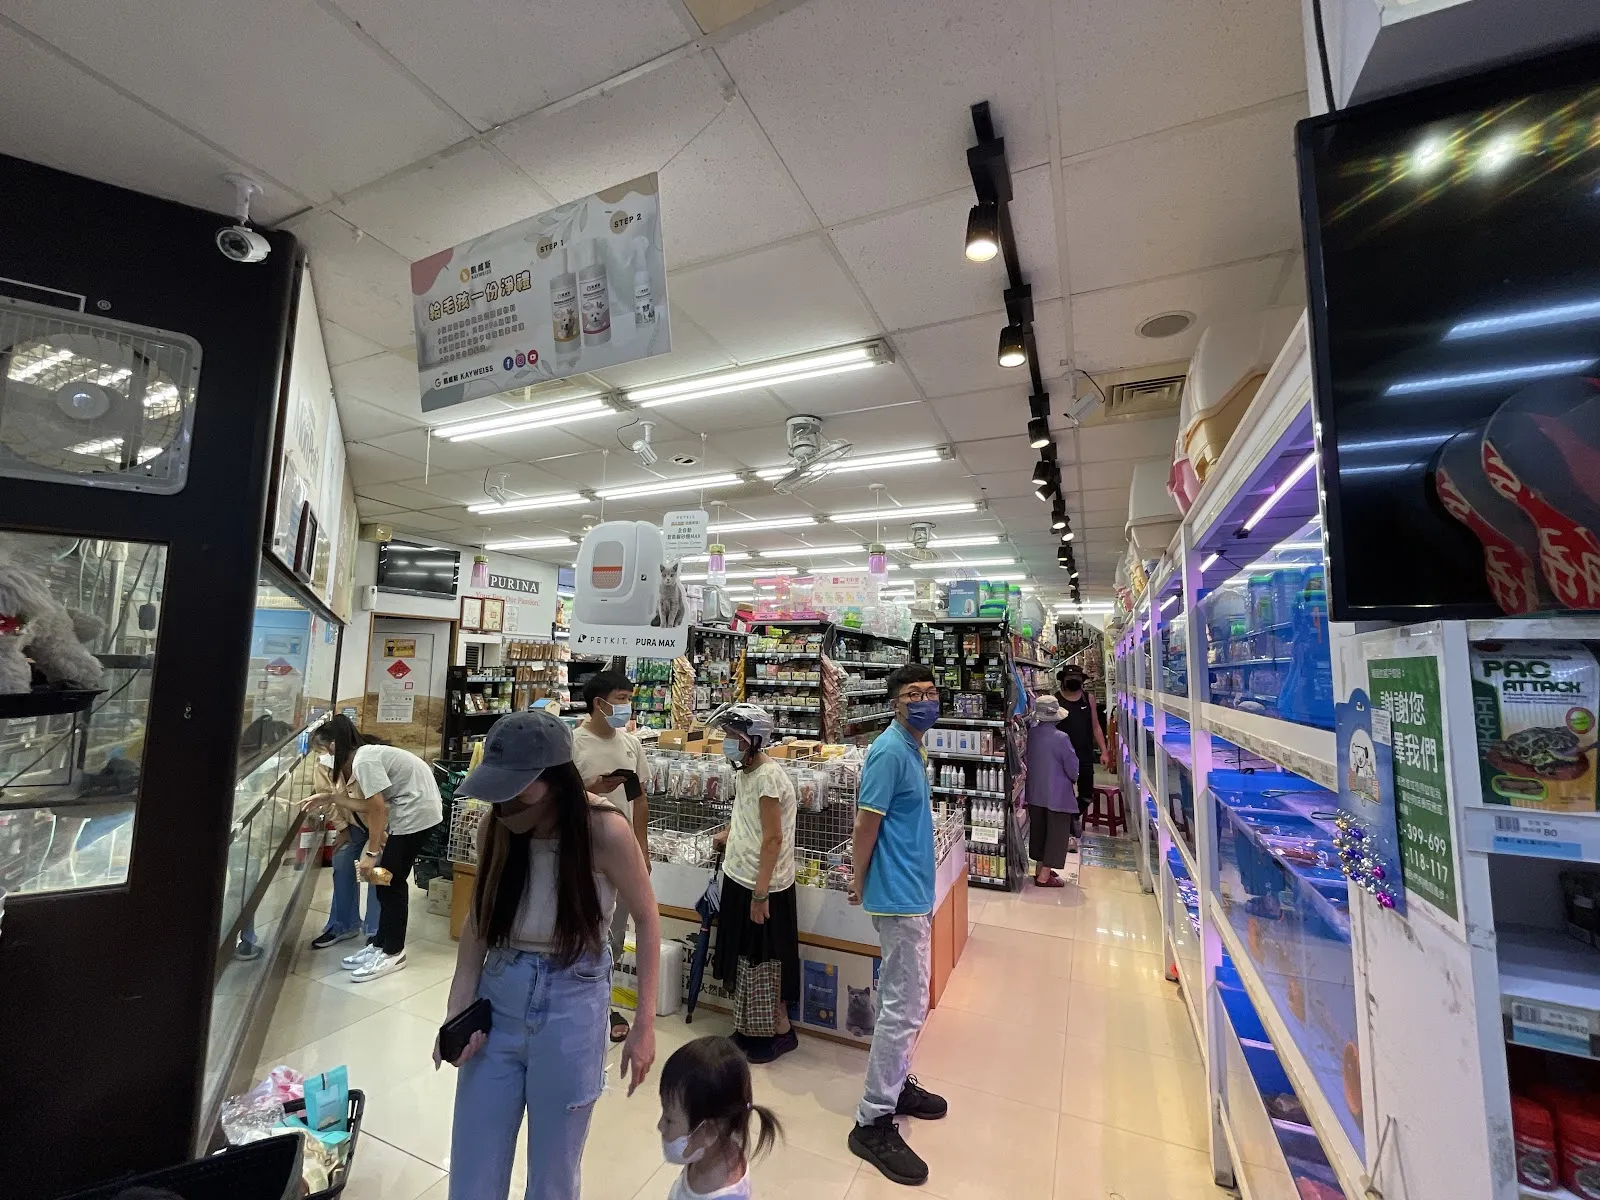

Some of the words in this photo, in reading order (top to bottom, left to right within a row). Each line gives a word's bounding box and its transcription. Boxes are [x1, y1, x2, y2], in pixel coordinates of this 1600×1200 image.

[614, 215, 634, 228] STEP
[637, 213, 642, 221] 2
[540, 242, 558, 253] STEP
[429, 269, 531, 321] 給毛孩一份淨禮
[460, 365, 494, 380] KAYWEISS
[490, 576, 538, 593] PURINA
[636, 638, 657, 647] PURA
[658, 639, 676, 648] MAX
[1482, 660, 1551, 678] PAC
[1503, 680, 1580, 693] ATTACK
[1380, 691, 1426, 726] 謝謝您
[1544, 828, 1558, 836] 80
